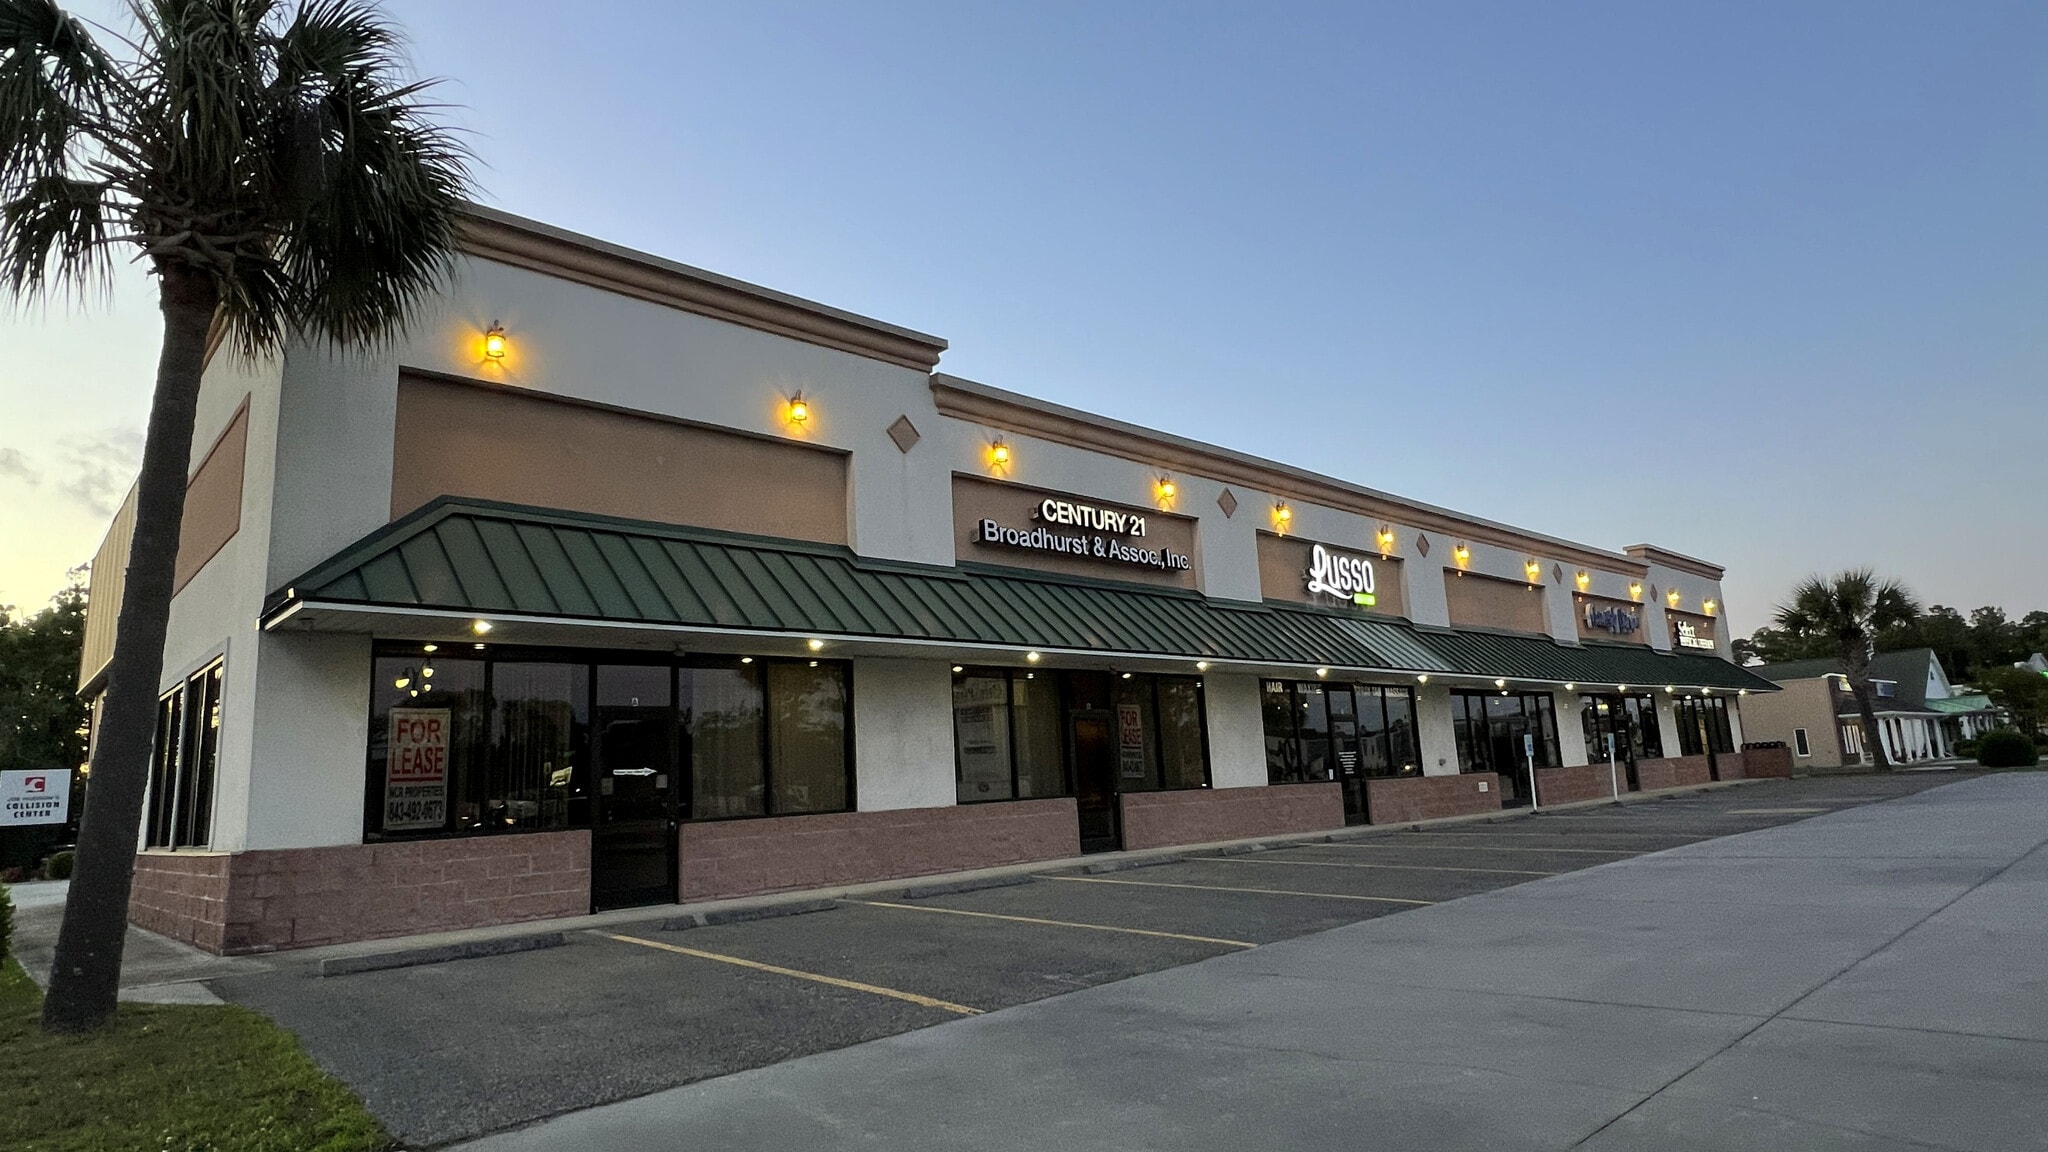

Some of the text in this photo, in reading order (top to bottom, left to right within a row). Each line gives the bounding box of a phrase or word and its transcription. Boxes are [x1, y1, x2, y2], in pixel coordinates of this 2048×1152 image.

[1042, 499, 1147, 537] CENTURY 21
[984, 518, 1089, 555] Broadhurst
[1092, 536, 1106, 558] &
[397, 718, 441, 744] FOR
[1120, 710, 1138, 726] FOR
[392, 747, 444, 774] LEASE
[6, 802, 60, 810] COLLISION
[13, 810, 51, 818] CENTER
